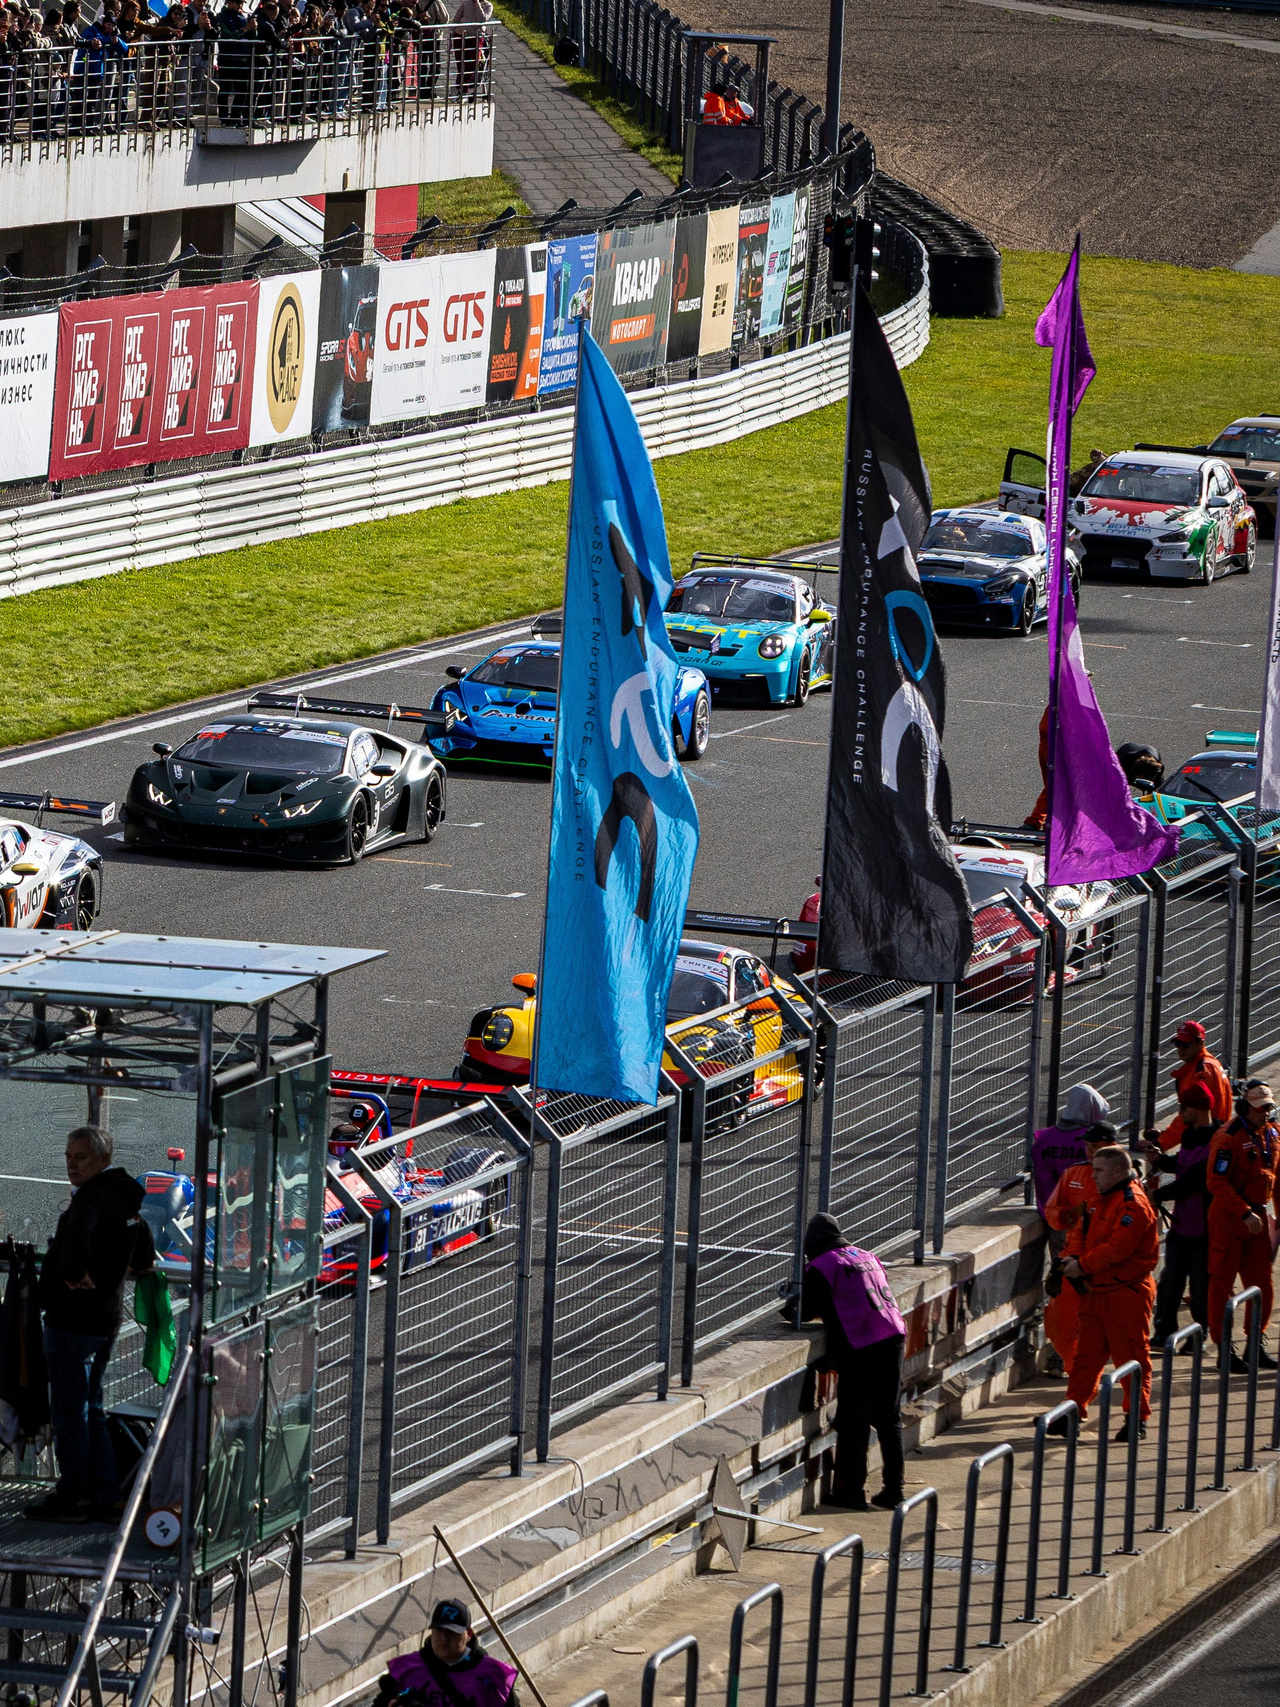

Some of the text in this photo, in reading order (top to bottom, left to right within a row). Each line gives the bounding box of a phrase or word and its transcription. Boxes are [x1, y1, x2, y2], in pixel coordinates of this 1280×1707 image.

[613, 256, 660, 306] КВАЗАР
[385, 298, 430, 351] GTS
[443, 291, 486, 343] GTS
[611, 318, 647, 340] МОТОСПОРТ
[279, 365, 299, 403] PLACE
[1097, 468, 1120, 476] 51
[258, 720, 303, 729] GTS
[853, 669, 865, 785] CHALLENGE
[683, 960, 724, 975] СИНТЕРА
[1041, 1146, 1086, 1161] MEDIA
